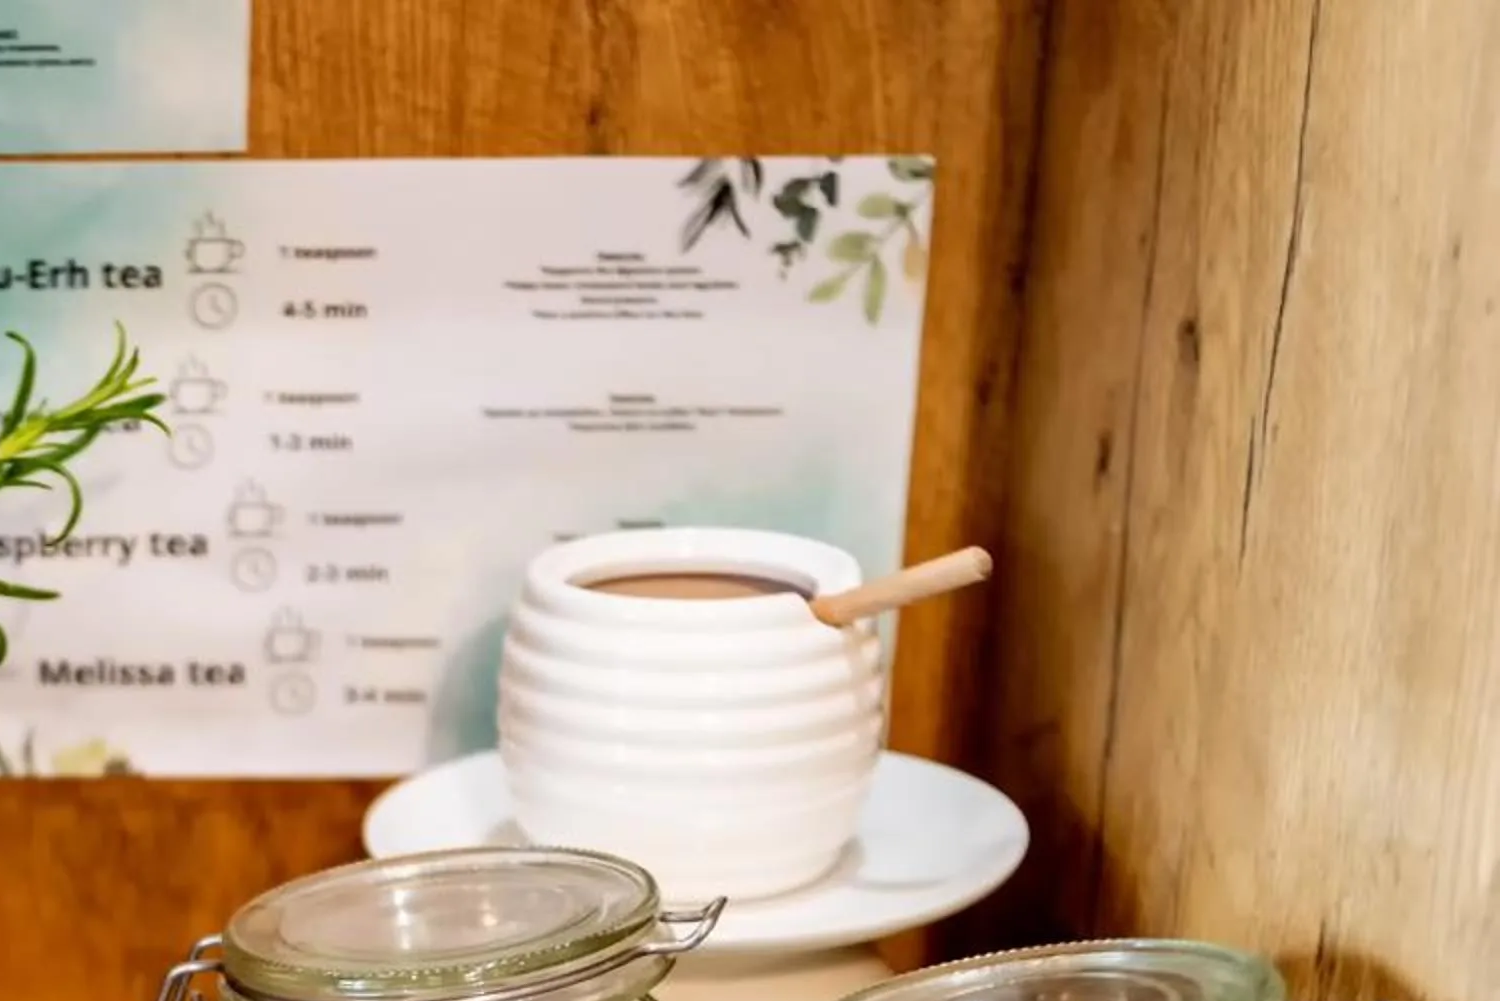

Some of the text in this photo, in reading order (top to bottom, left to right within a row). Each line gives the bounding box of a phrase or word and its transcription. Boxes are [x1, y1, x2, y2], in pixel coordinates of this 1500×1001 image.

[102, 262, 163, 289] tea
[325, 301, 368, 318] min
[150, 532, 209, 558] tea
[38, 657, 246, 687] Melissa tea
